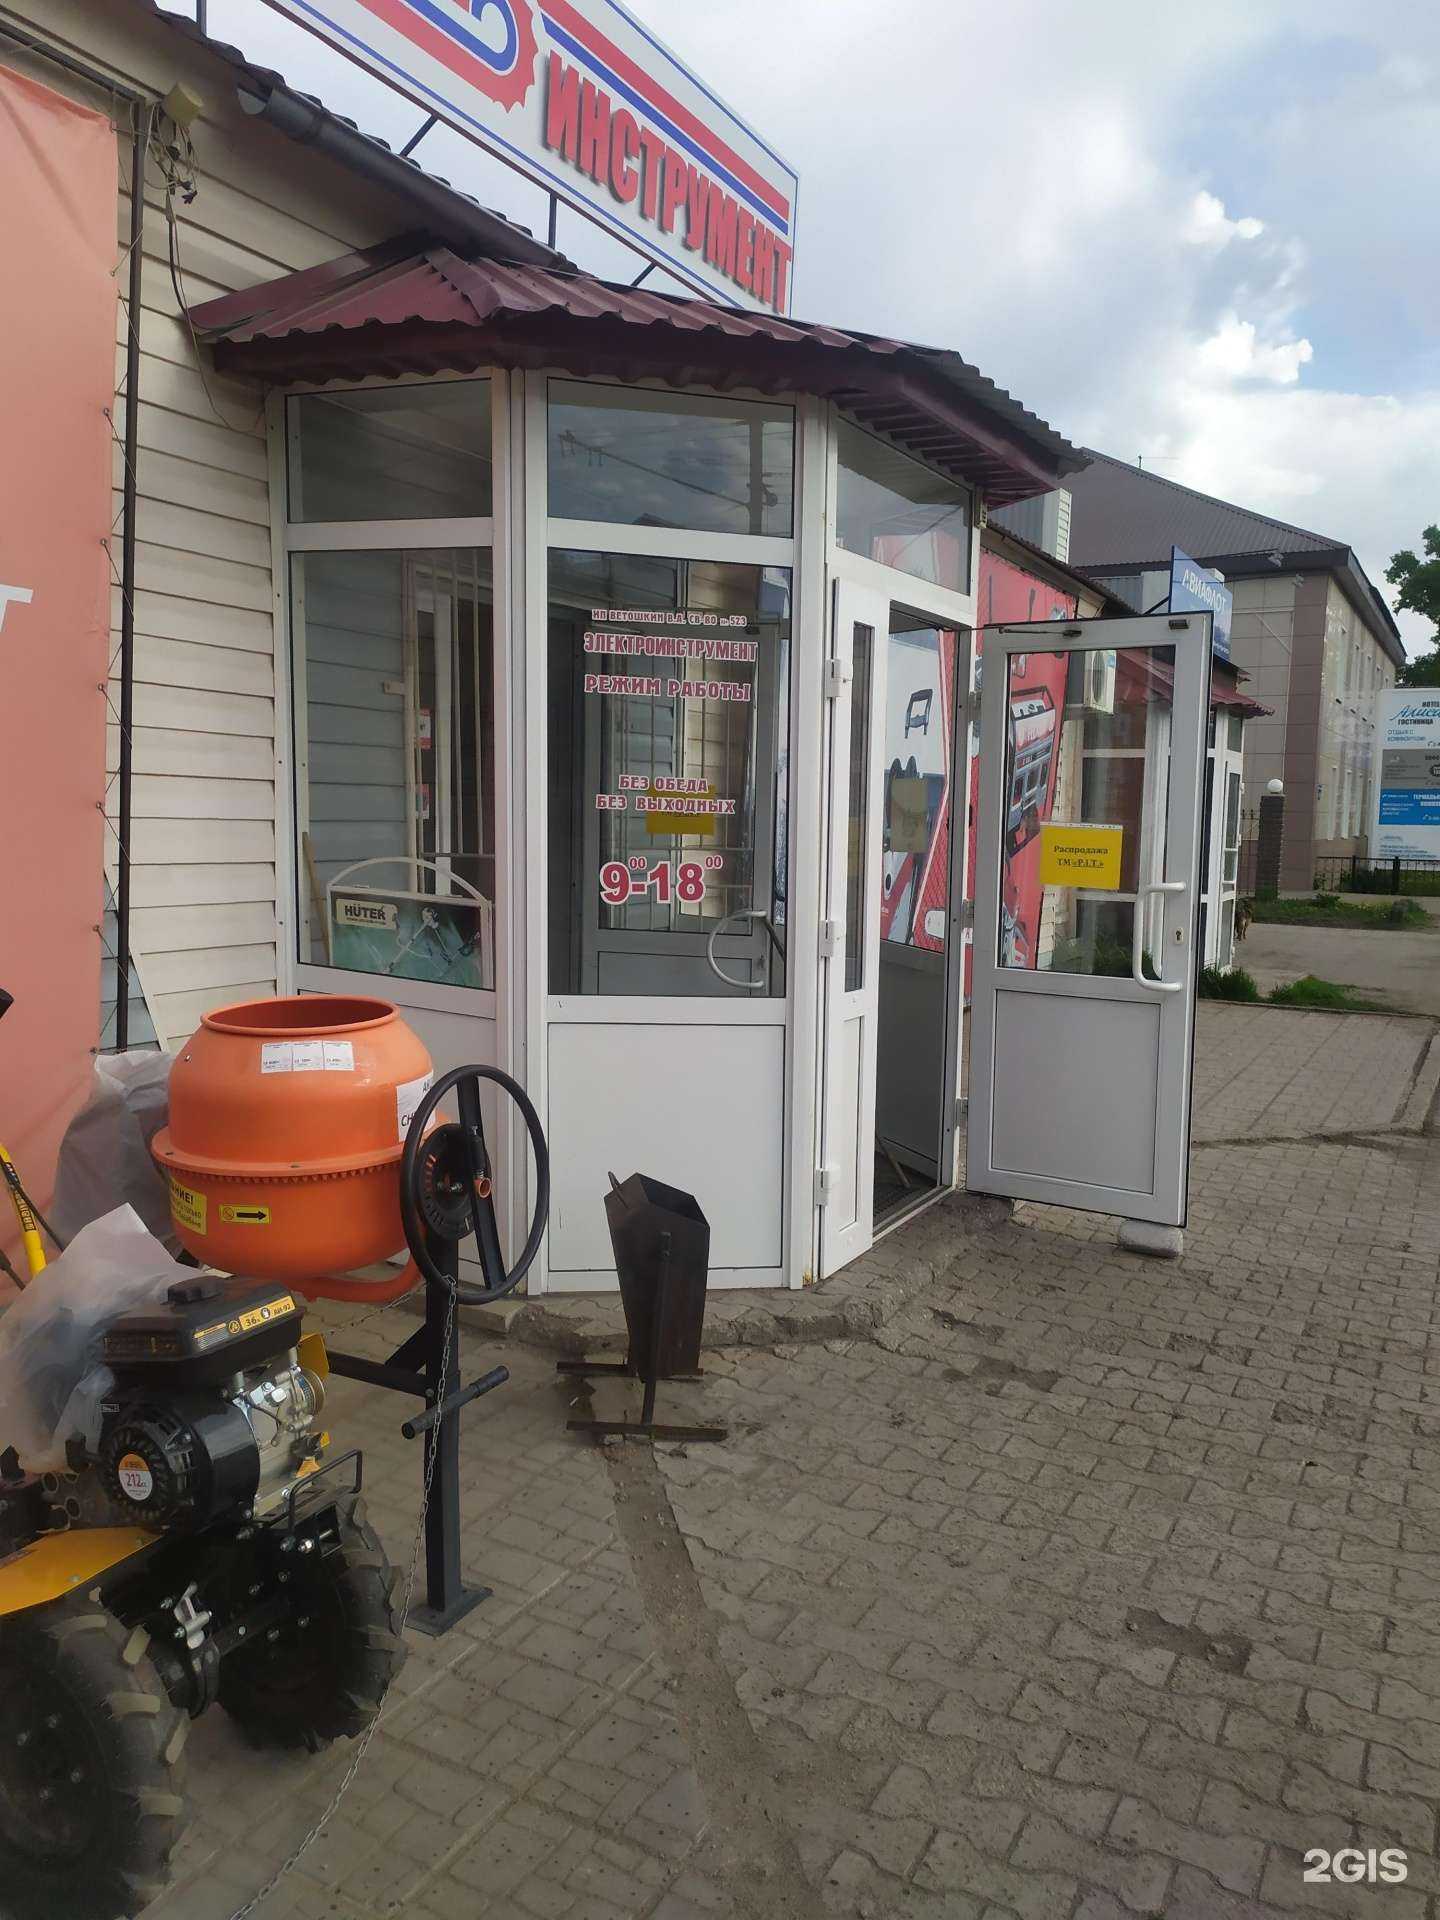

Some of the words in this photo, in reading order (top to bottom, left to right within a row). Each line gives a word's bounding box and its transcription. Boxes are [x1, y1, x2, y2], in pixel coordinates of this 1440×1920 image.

[546, 49, 792, 315] ИНСТРУМЕНТ
[592, 609, 607, 620] ИП
[729, 616, 747, 626] 523
[584, 632, 758, 662] ЭЛЕКТРОИНСТРУМЕНТ
[584, 674, 661, 696] РЕЖИМ
[667, 679, 751, 701] РАБОТЫ
[619, 775, 650, 791] БЕЗ
[654, 777, 709, 793] ОБЕДА
[596, 794, 627, 810] БЕЗ
[635, 796, 735, 814] ВЫХОДНЫХ
[1054, 845, 1109, 856] Распродажа
[344, 903, 386, 921] HÜTER
